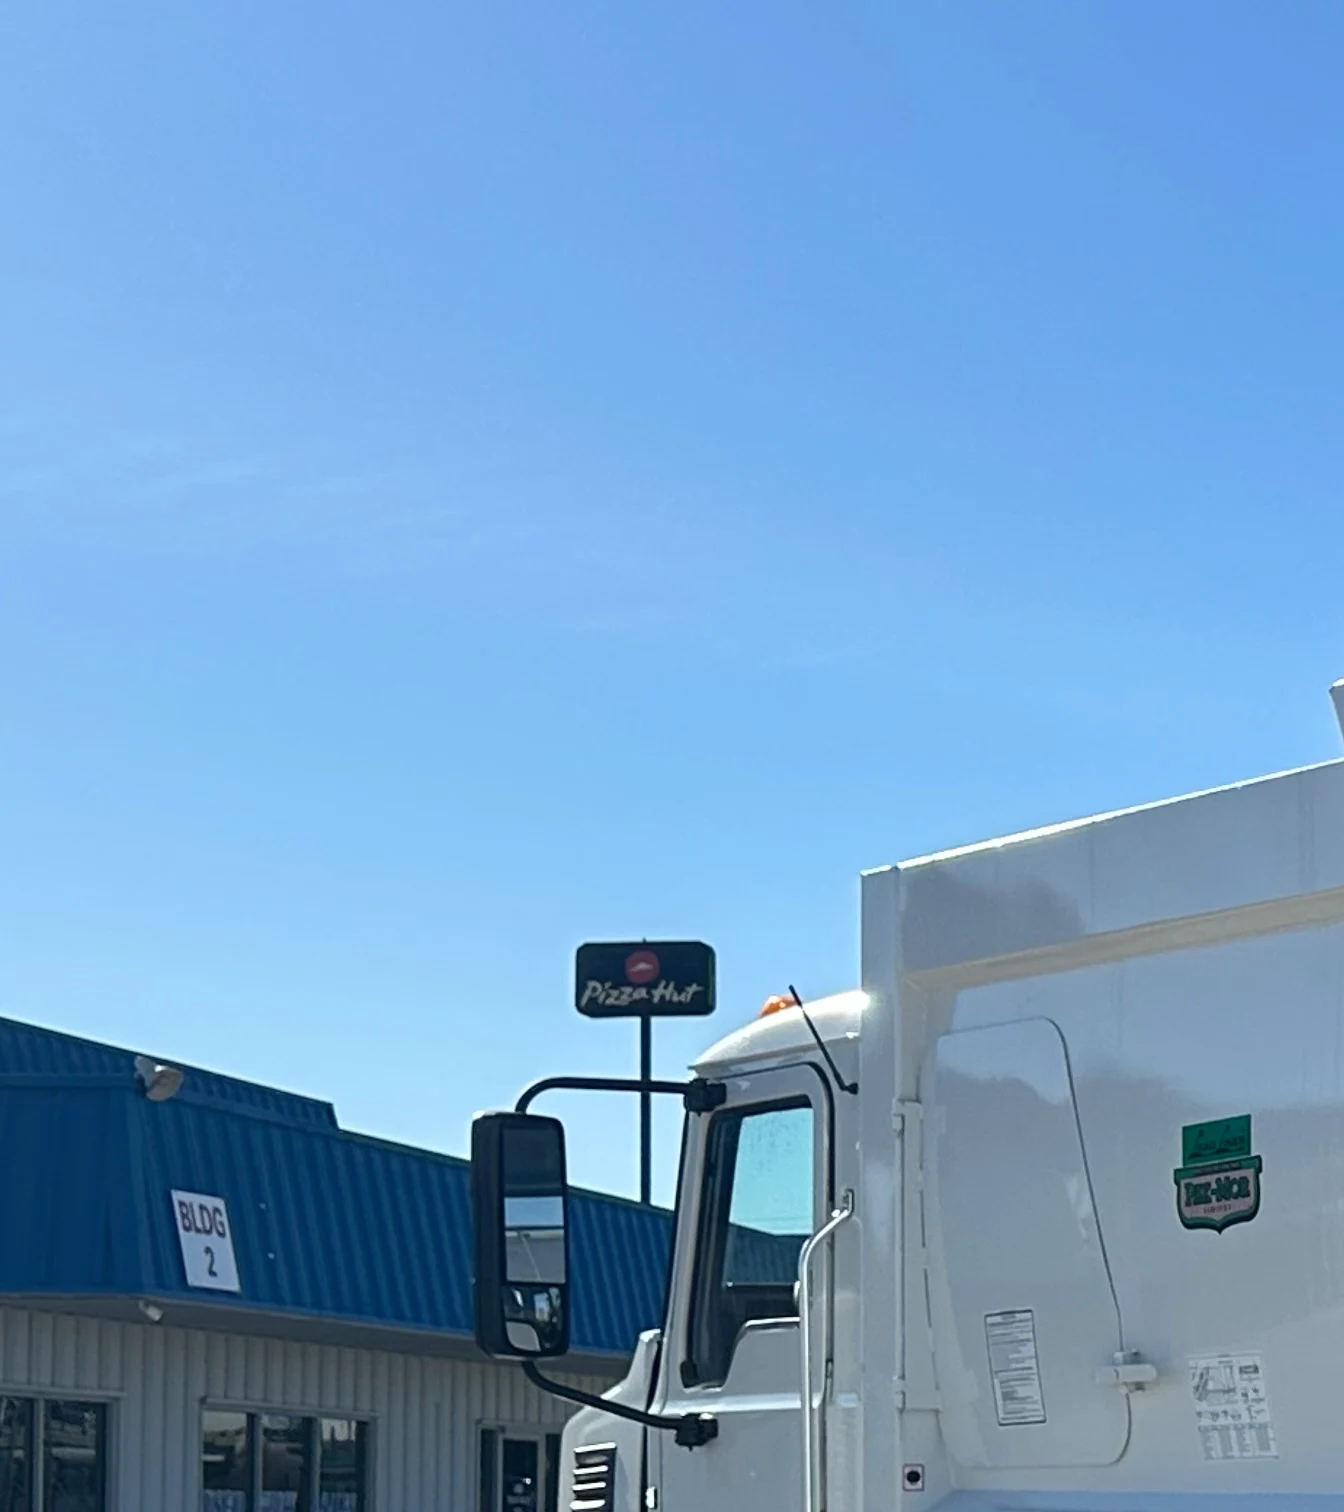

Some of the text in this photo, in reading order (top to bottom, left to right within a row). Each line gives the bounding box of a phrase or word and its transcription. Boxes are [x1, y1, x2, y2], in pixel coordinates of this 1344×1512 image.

[580, 979, 704, 1008] Pizza Hut
[178, 1200, 226, 1239] BLDG
[204, 1246, 218, 1277] 2
